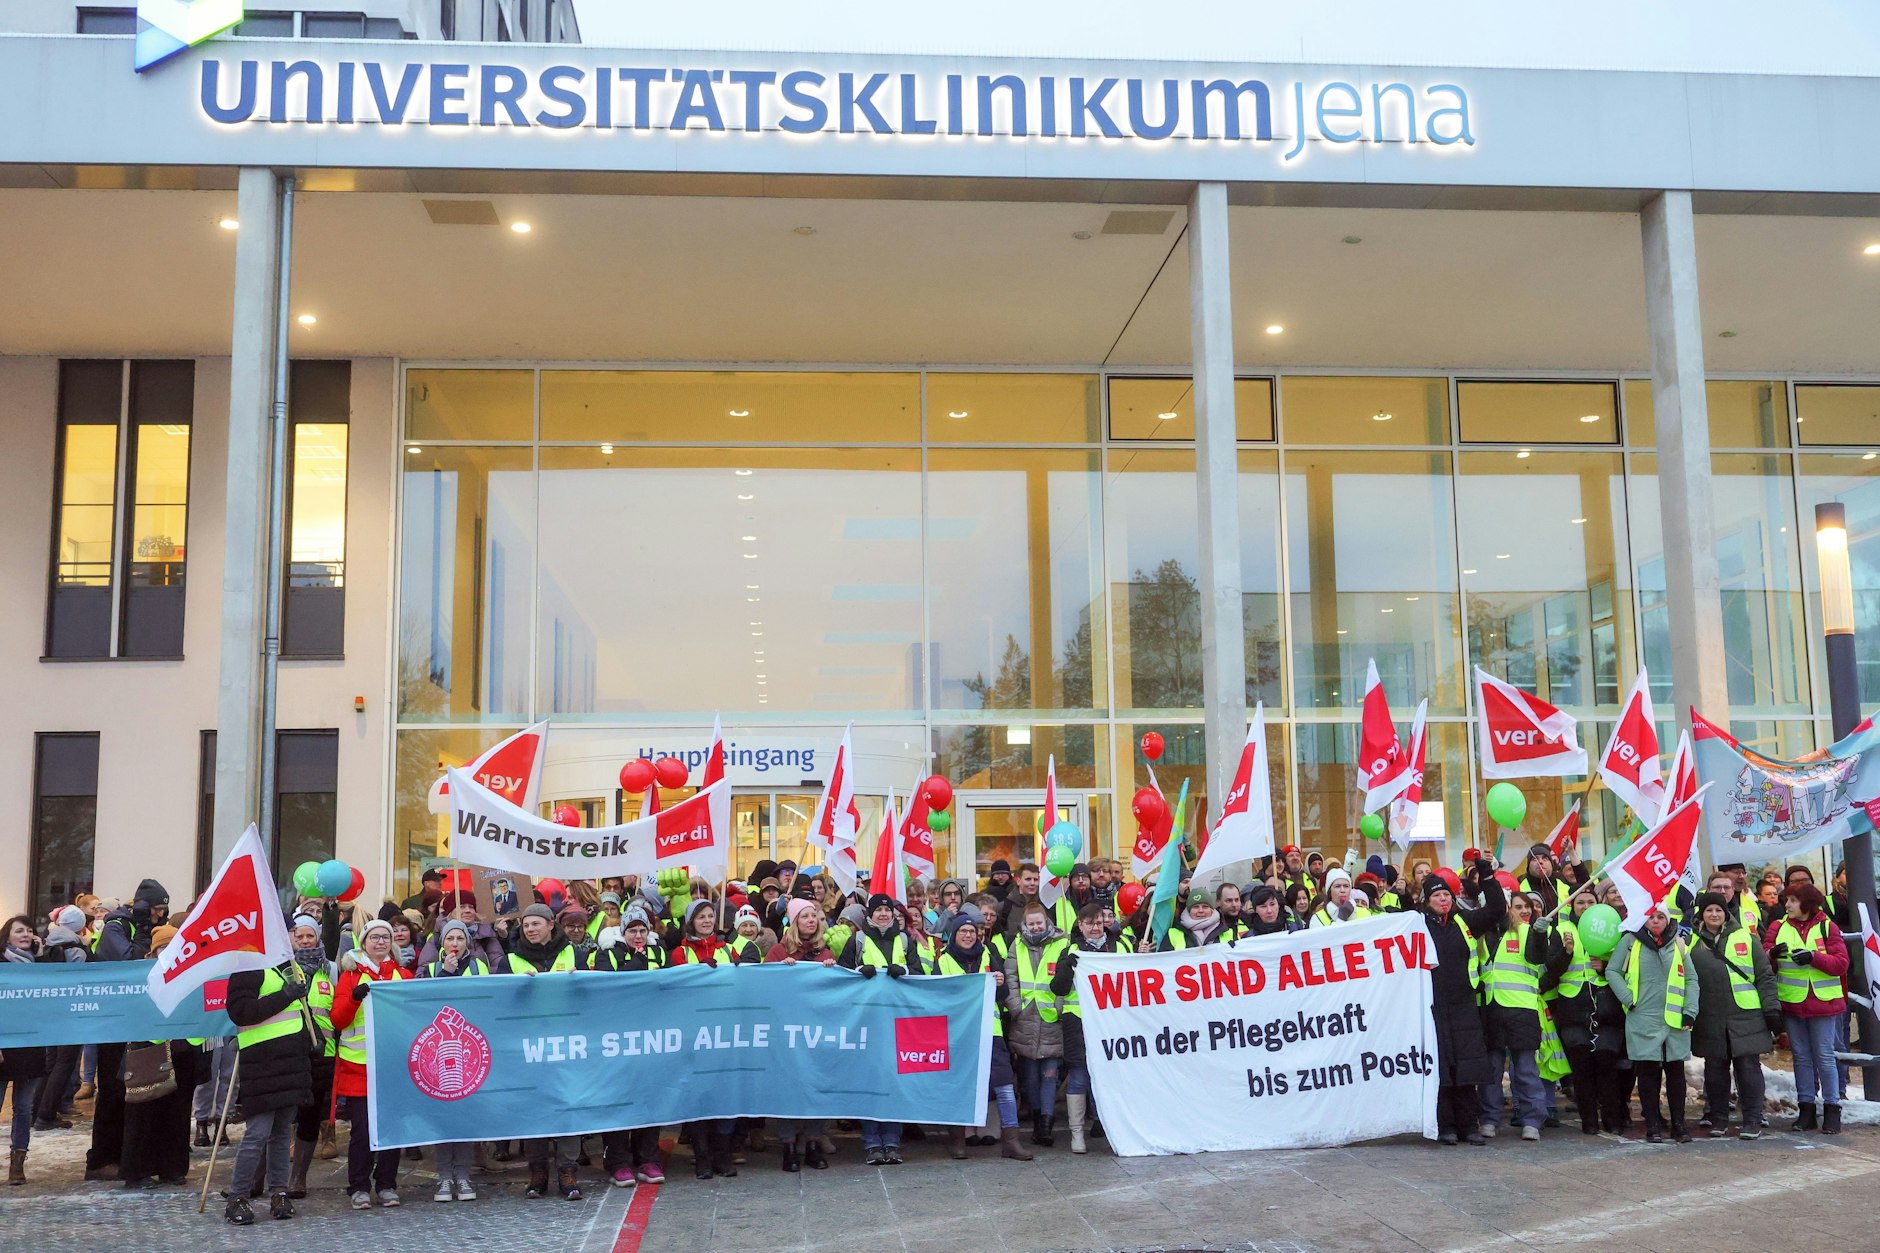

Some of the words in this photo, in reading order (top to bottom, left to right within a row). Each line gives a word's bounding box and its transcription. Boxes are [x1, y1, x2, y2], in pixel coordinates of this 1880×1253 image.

[1285, 80, 1475, 160] jena
[457, 809, 630, 858] Warnstreik
[659, 824, 708, 847] ver.di
[1053, 833, 1073, 846] 38,5
[1088, 968, 1166, 1010] WIR
[1175, 960, 1266, 1003] SIND
[1279, 942, 1370, 992] ALLE
[70, 1002, 99, 1012] JENA
[411, 1045, 421, 1062] WIR
[418, 1027, 436, 1044] SIND
[464, 1025, 483, 1041] ALLE
[522, 1036, 587, 1063] WIR
[602, 1028, 682, 1057] SIND
[693, 1024, 770, 1050] ALLE
[783, 1026, 867, 1050] TV-L!
[1101, 1035, 1148, 1061] von
[1155, 1026, 1200, 1057] der
[1207, 1003, 1368, 1053] Pflegekraft
[899, 1049, 945, 1065] ver.di
[1247, 1066, 1289, 1098] bis
[1296, 1063, 1354, 1092] zum
